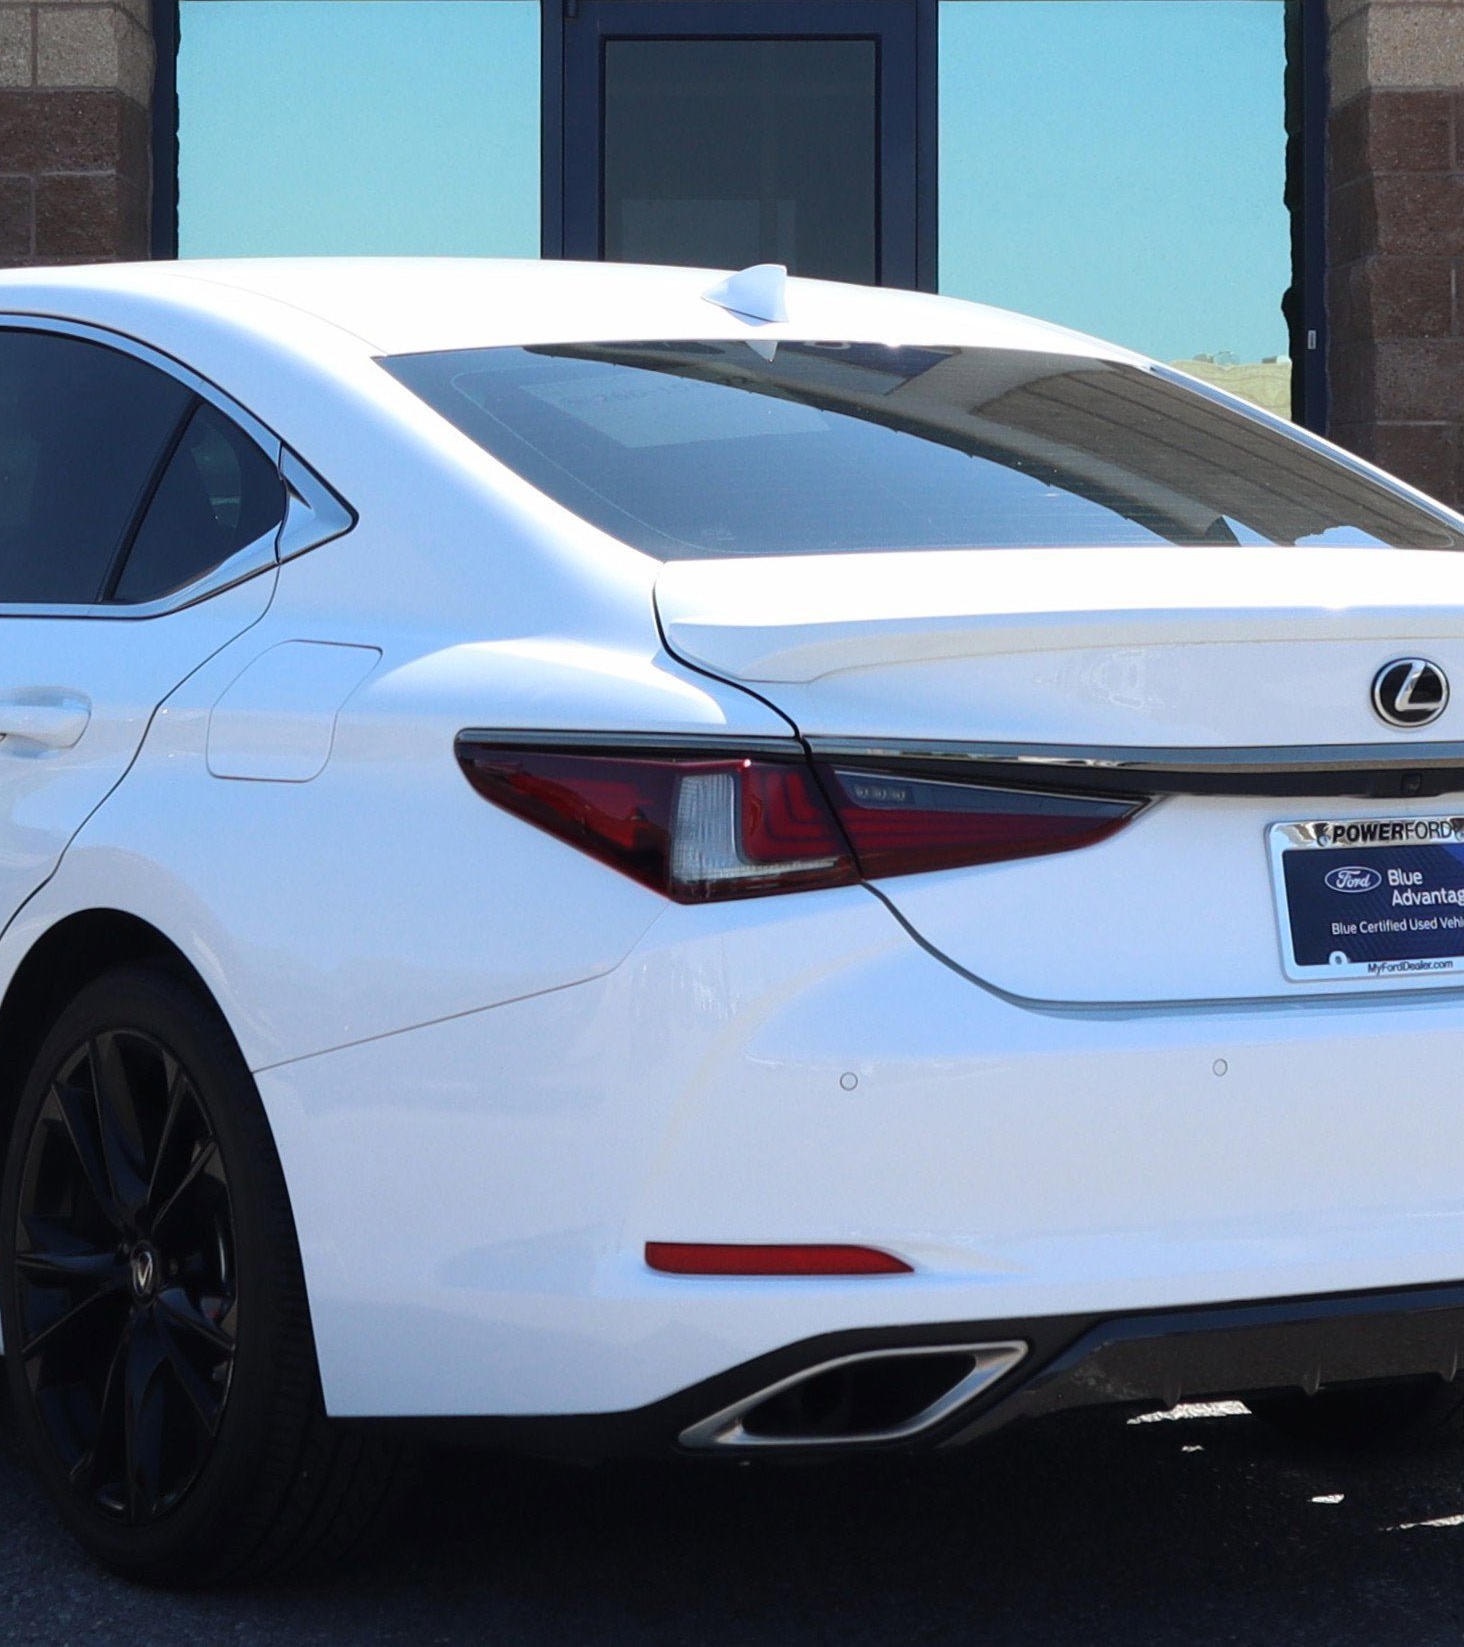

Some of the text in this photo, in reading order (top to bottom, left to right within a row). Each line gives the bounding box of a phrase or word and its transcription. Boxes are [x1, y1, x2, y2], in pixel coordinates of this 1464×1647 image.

[1336, 870, 1371, 889] Ford
[1387, 868, 1424, 886] Blue
[1331, 922, 1358, 935] Blue
[1359, 919, 1408, 934] Certified
[1409, 917, 1439, 931] Used
[1367, 959, 1454, 976] MyFordDealer.com
